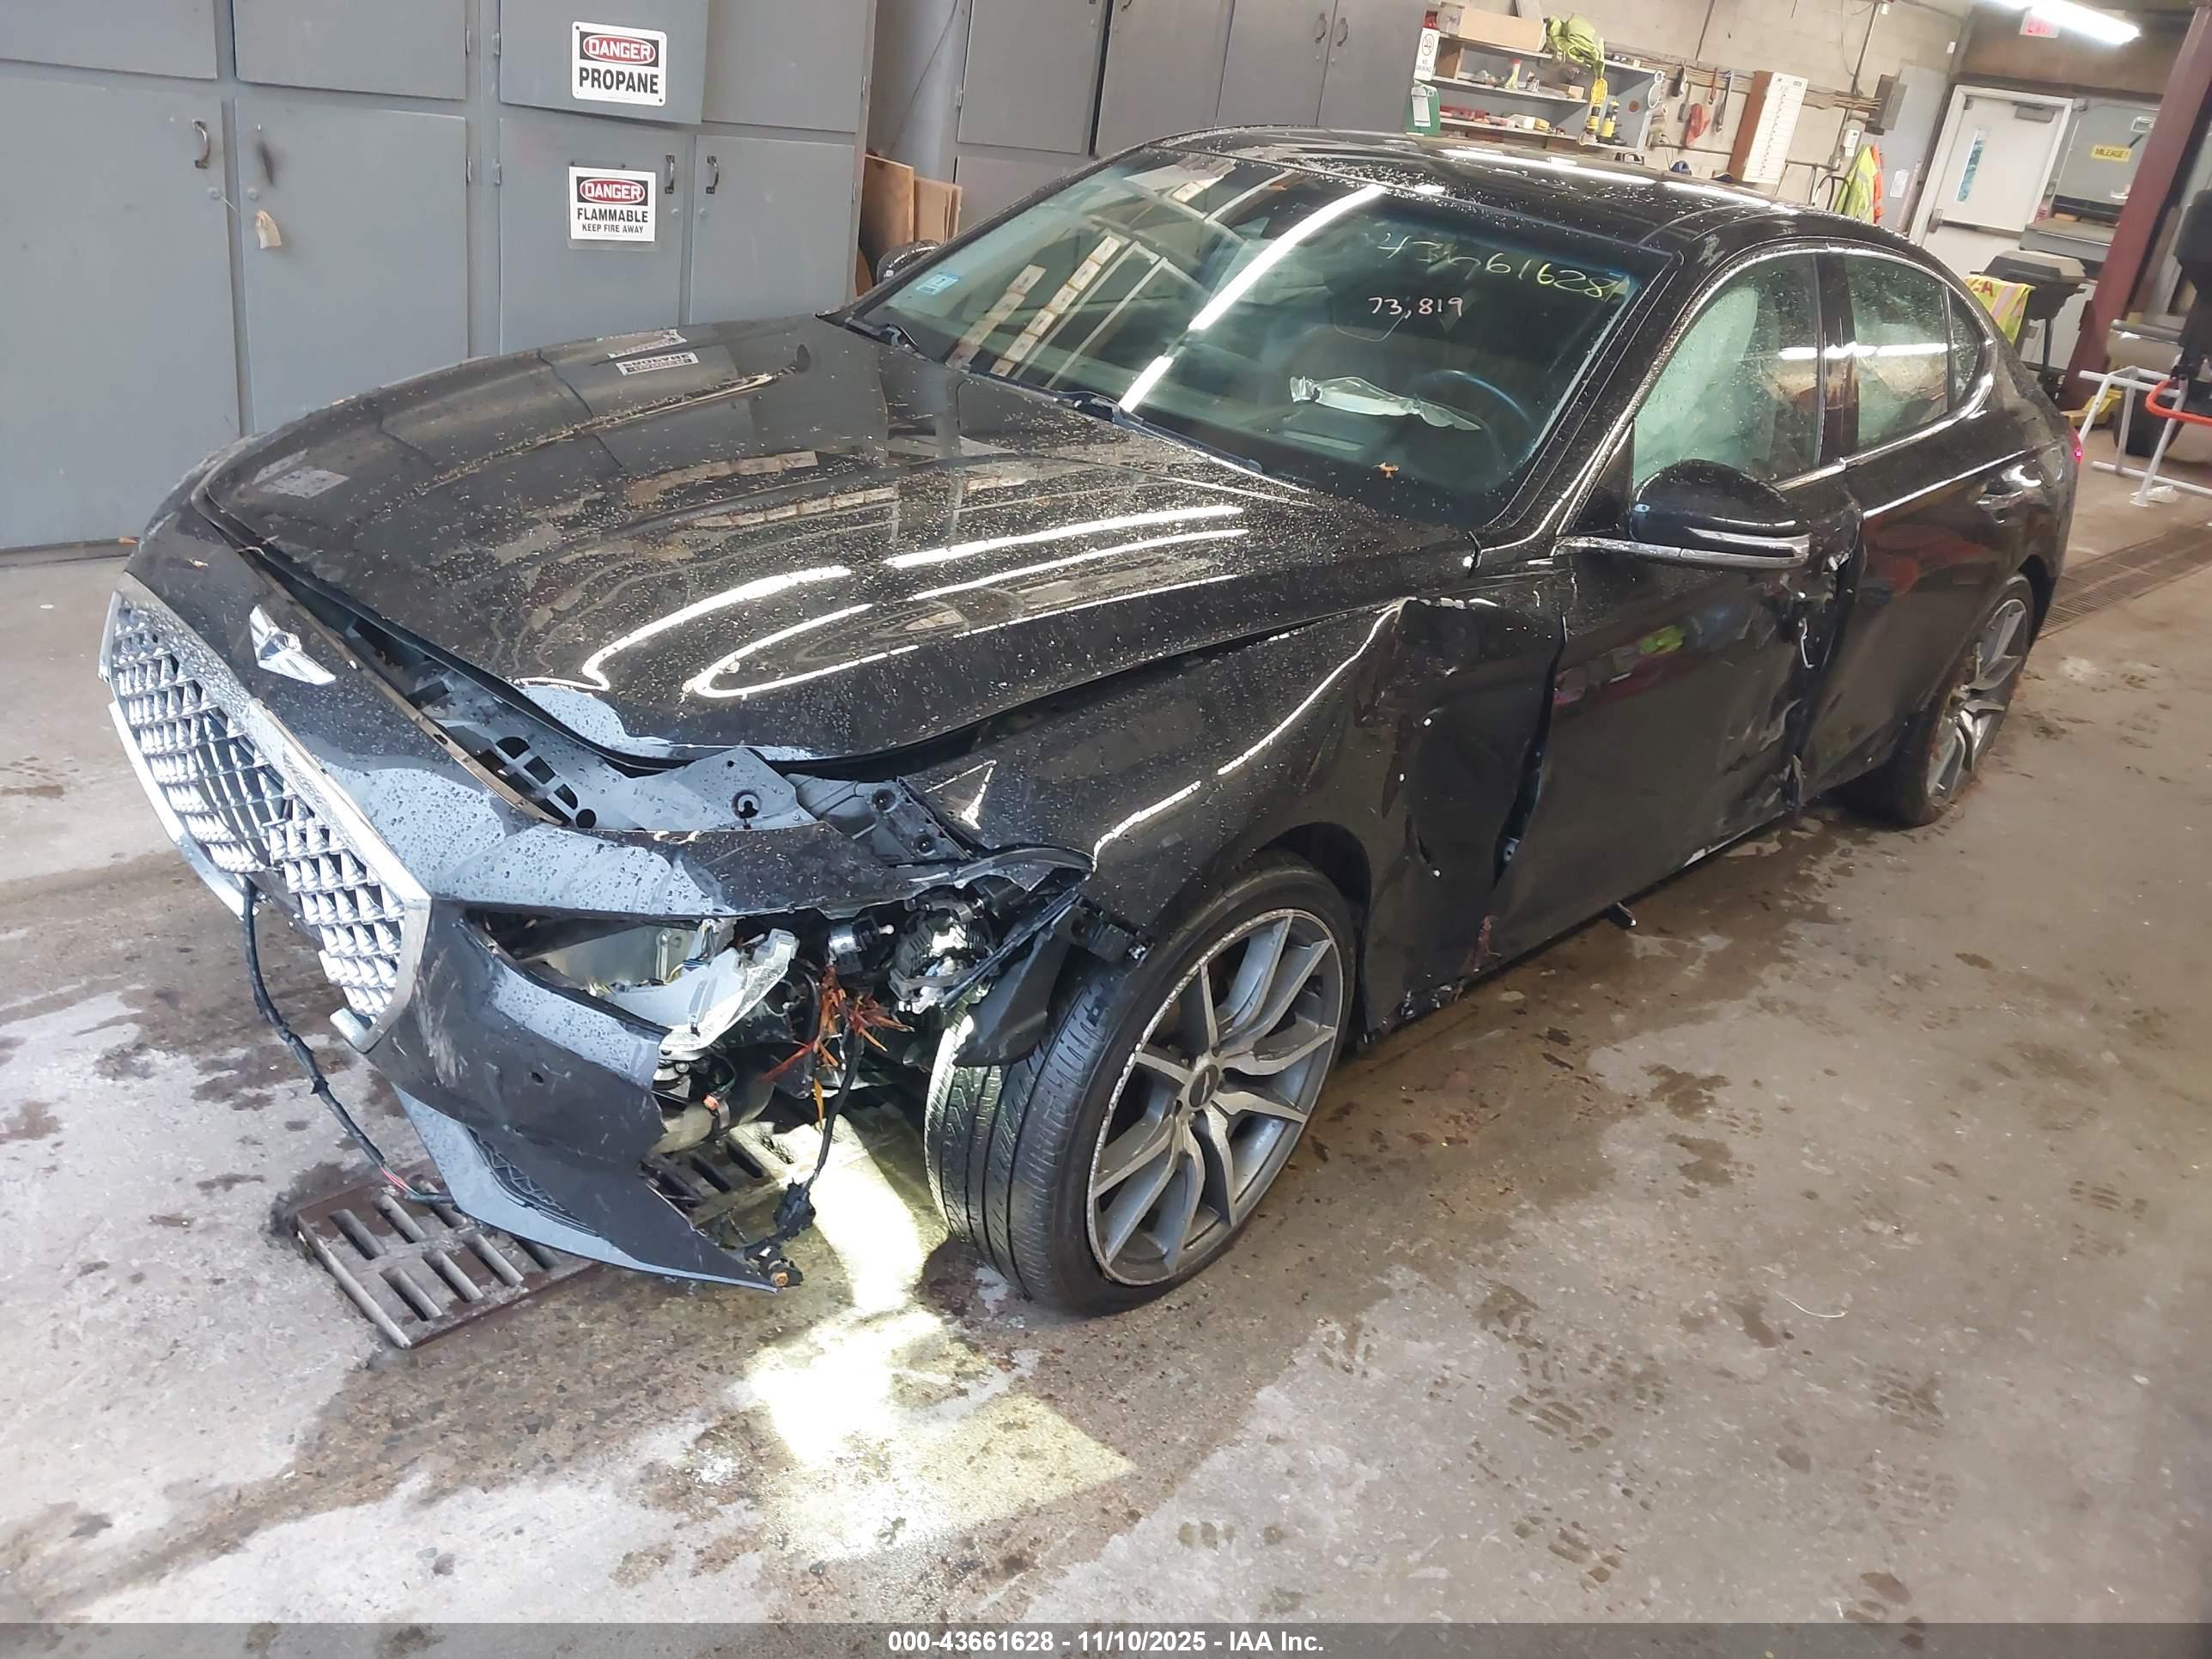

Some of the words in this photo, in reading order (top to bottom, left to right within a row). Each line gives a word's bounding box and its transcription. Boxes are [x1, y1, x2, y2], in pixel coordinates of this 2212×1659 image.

[588, 39, 652, 61] DANGER
[579, 67, 659, 94] PROPANE
[584, 182, 641, 200] DANGER
[577, 207, 648, 223] FLAMMABLE
[582, 223, 602, 233] KEEP
[604, 224, 621, 233] FIRE
[623, 225, 644, 234] AWAY
[1367, 296, 1464, 319] 73,819
